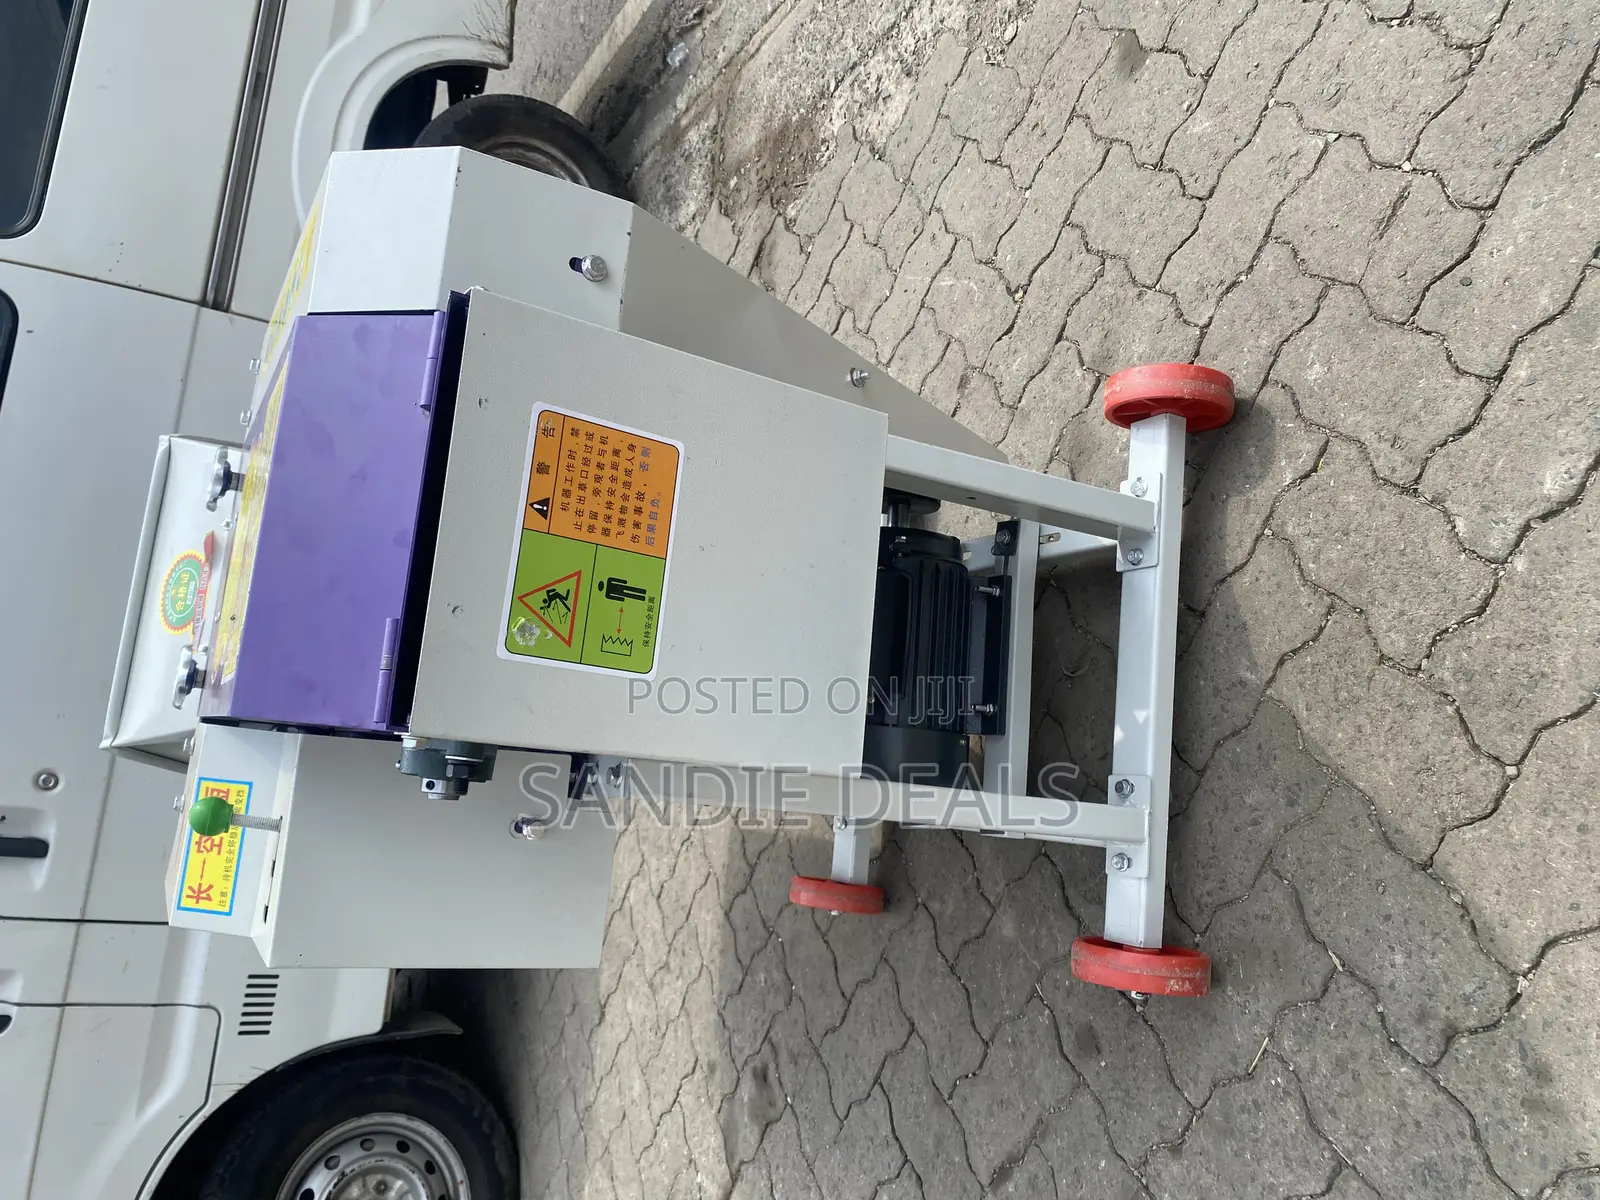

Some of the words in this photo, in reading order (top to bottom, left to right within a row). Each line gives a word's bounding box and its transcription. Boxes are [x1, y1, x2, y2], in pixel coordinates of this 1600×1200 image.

[536, 425, 556, 476] 警告
[573, 431, 595, 532] 止在出草口经过或
[615, 443, 637, 538] 飞溅物会造成人身
[642, 596, 656, 647] 保持安全距离
